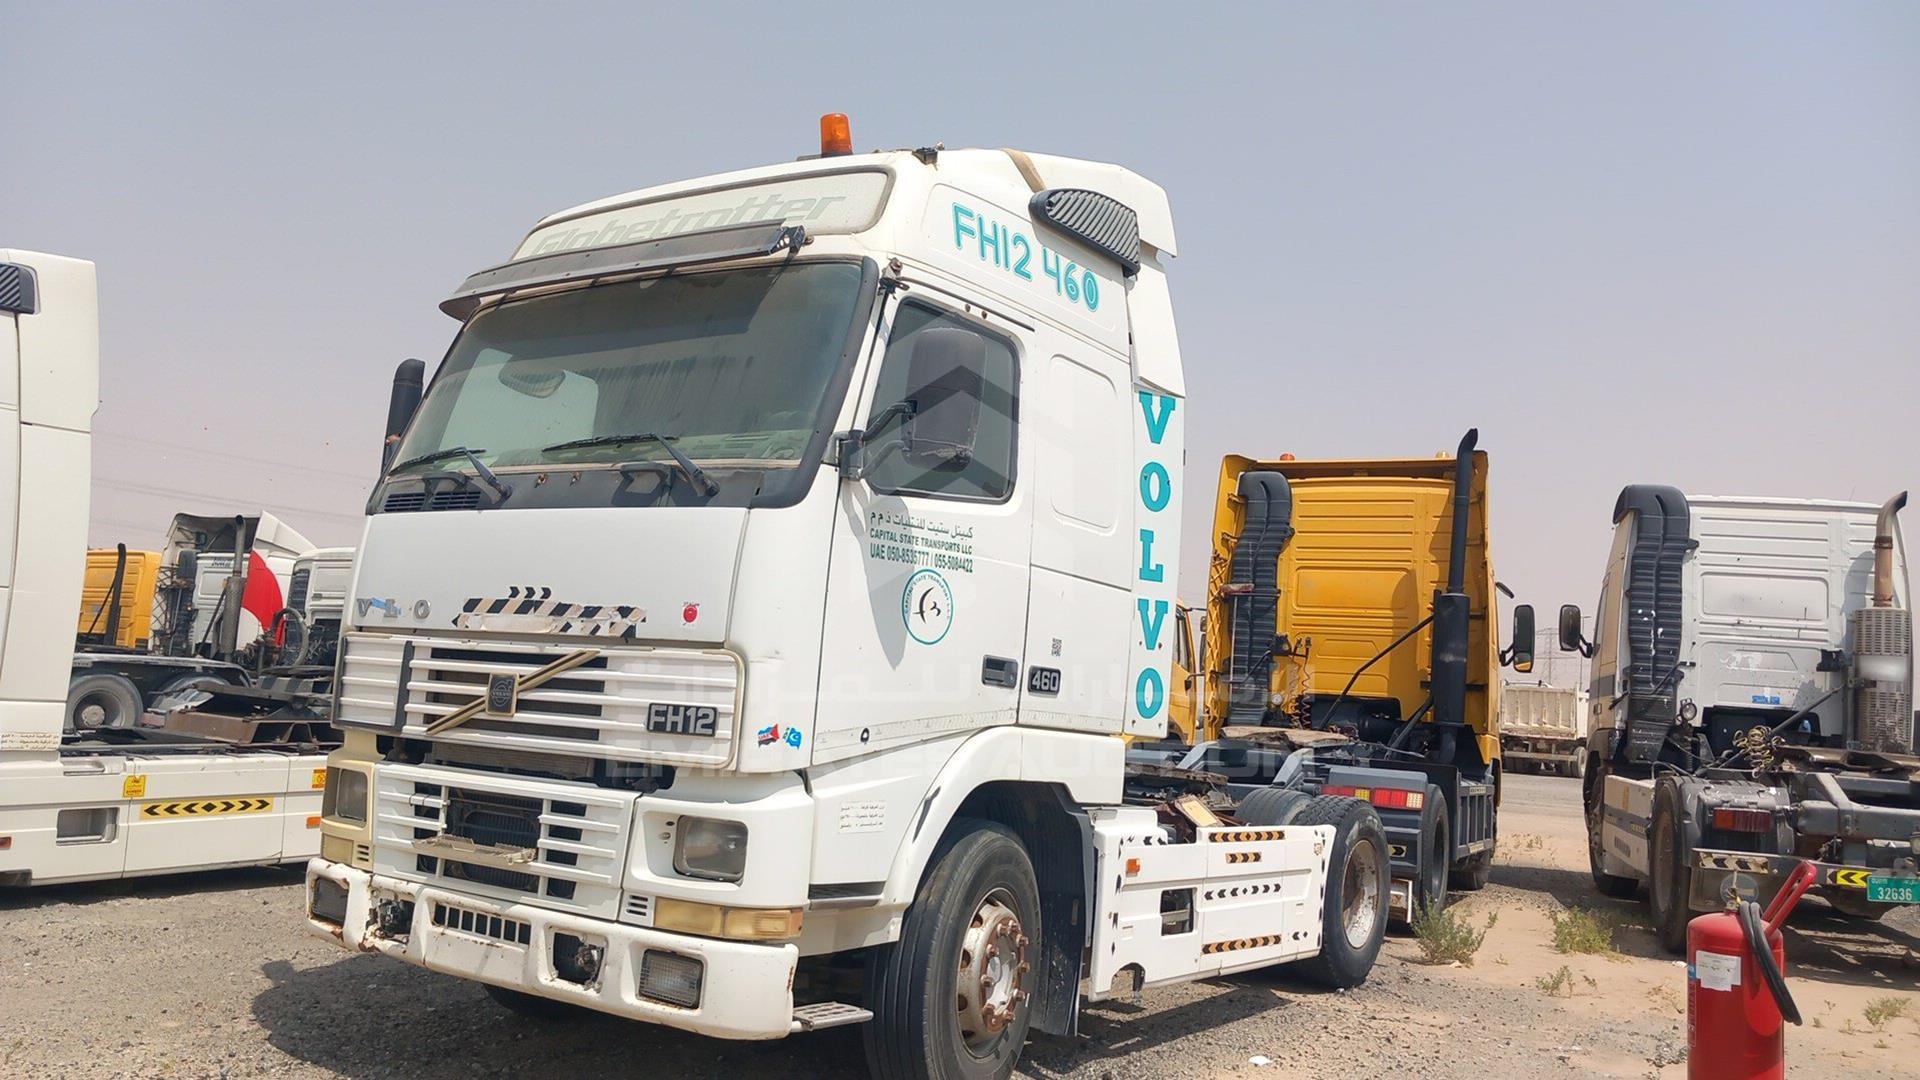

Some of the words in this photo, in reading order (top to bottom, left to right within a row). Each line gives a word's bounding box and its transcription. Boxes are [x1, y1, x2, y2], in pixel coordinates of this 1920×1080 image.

[952, 202, 1034, 281] FH12
[1042, 246, 1099, 312] 460
[870, 528, 898, 542] CAPITAL
[899, 533, 920, 546] STATE
[921, 537, 960, 553] TRANSPORTS
[961, 545, 973, 555] LLC
[870, 543, 885, 560] UAE
[1134, 391, 1176, 719] VOLVO
[1032, 670, 1059, 691] 460
[649, 705, 713, 735] FH12
[1877, 887, 1913, 901] 32636
